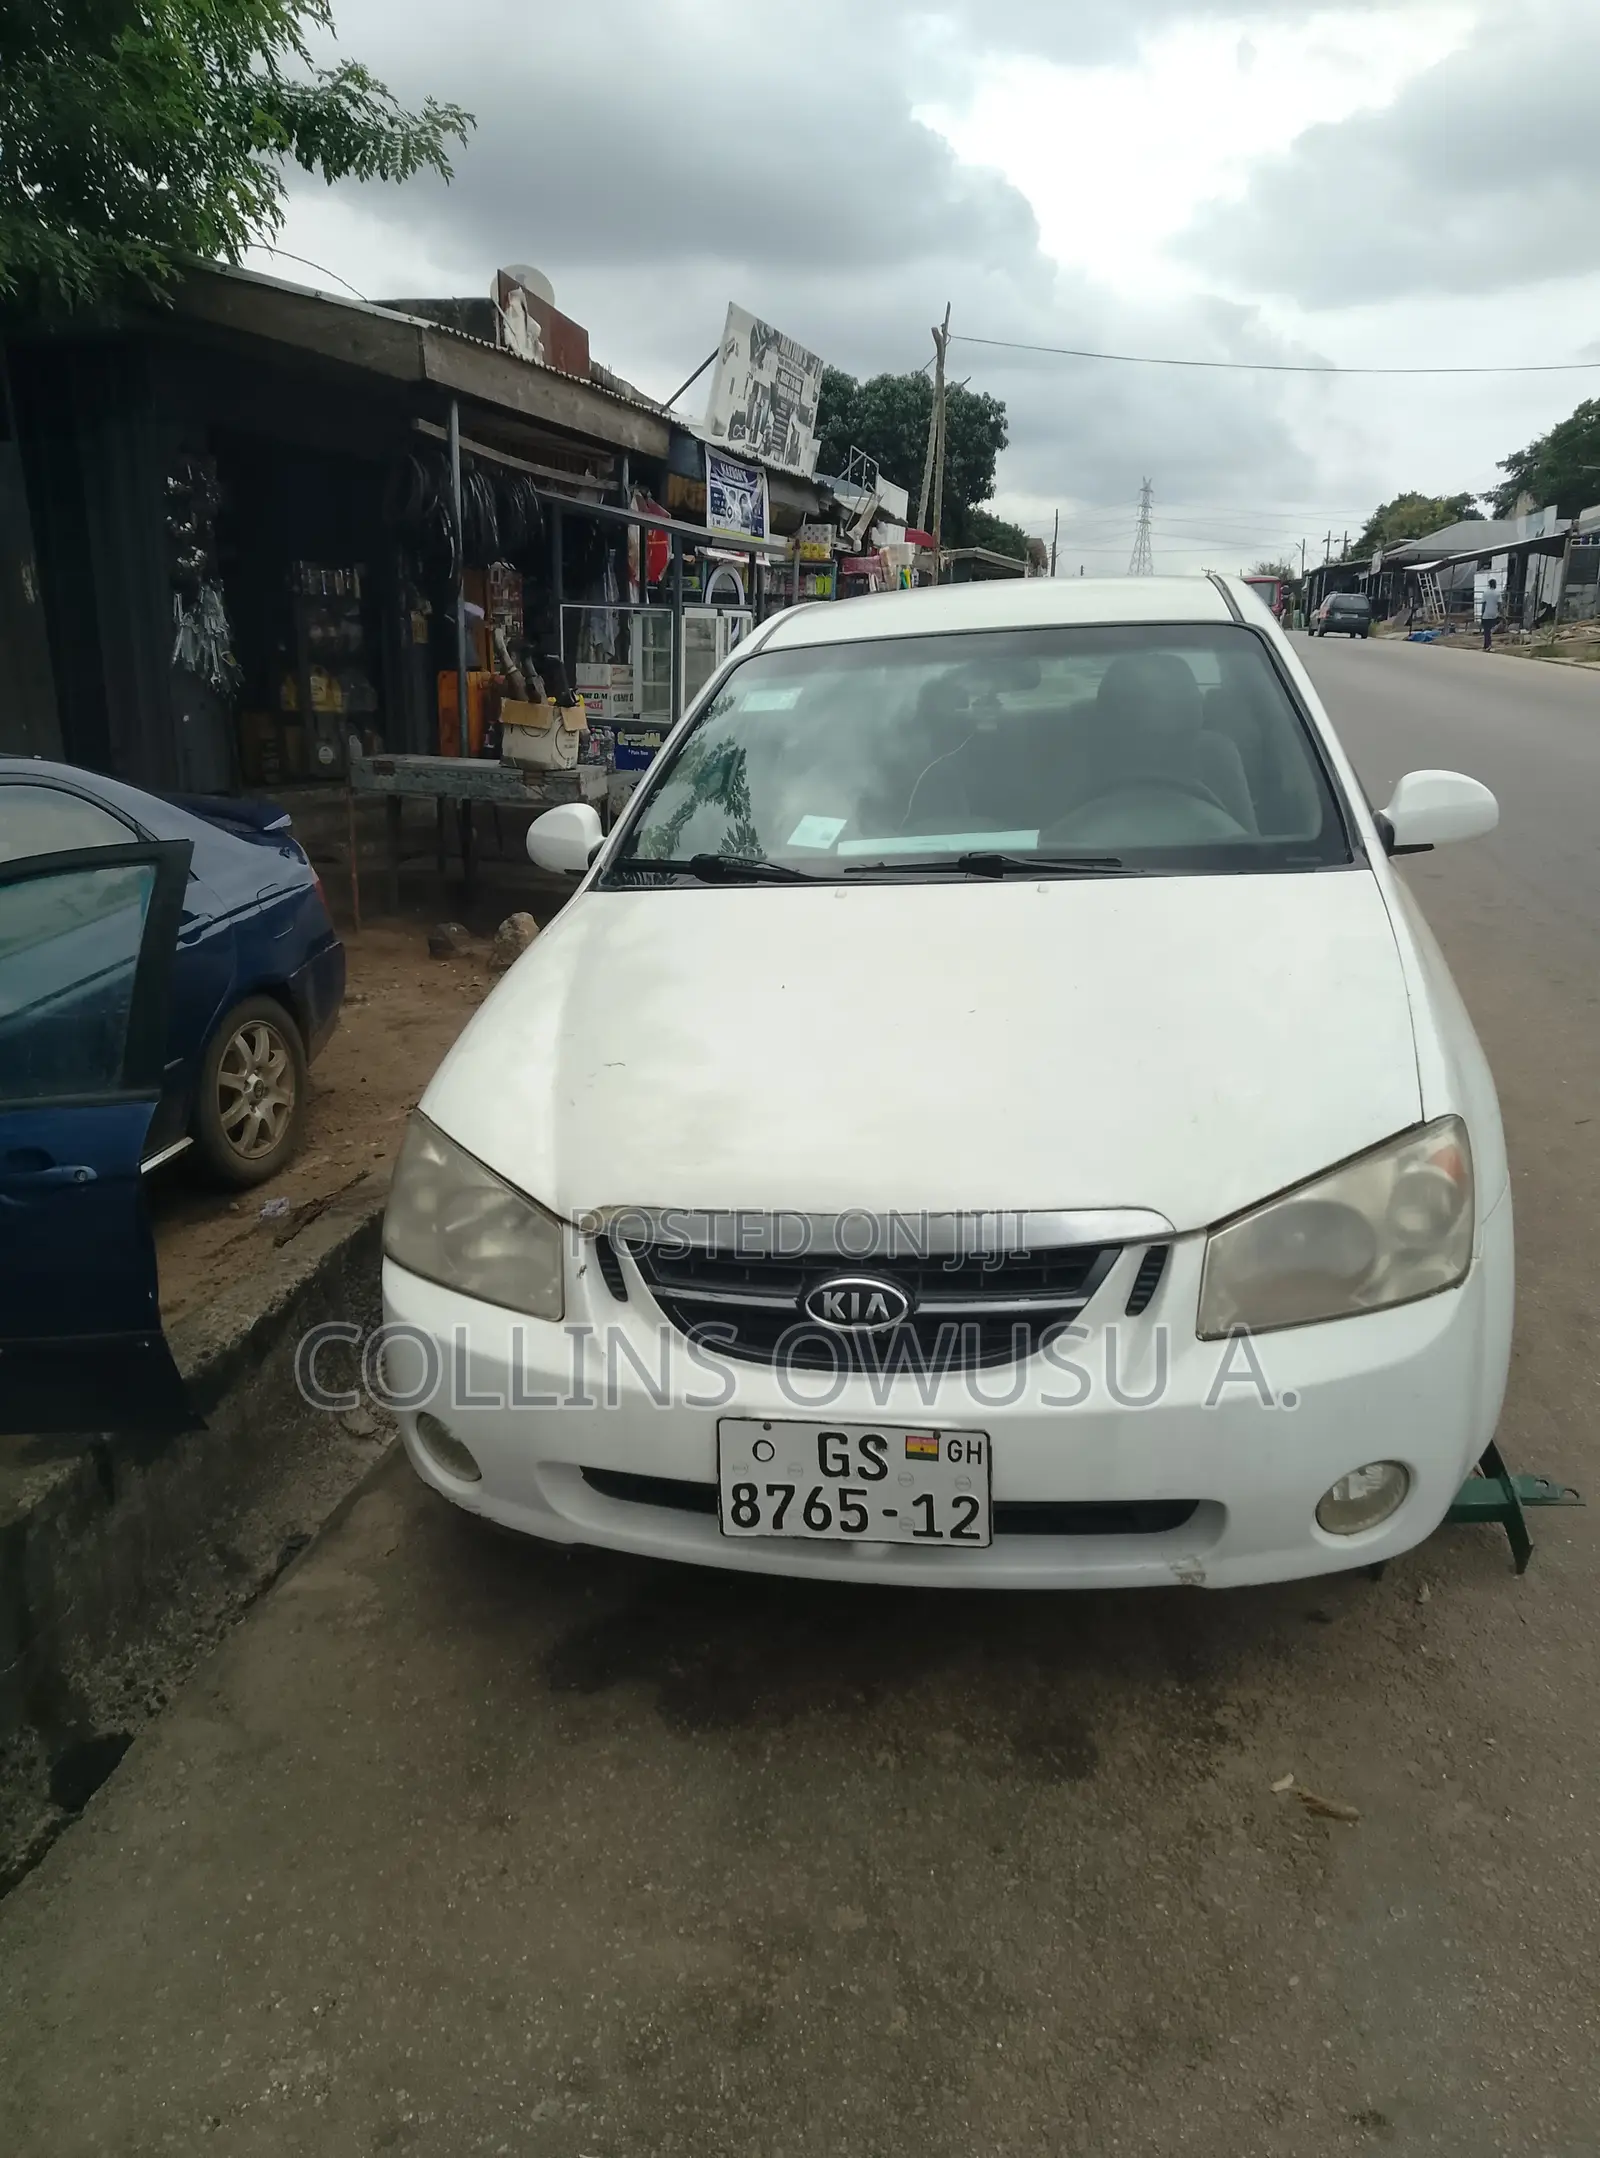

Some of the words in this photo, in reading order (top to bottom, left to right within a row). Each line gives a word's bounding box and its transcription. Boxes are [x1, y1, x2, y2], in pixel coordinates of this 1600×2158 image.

[823, 1292, 890, 1320] KIA
[817, 1431, 889, 1481] GS
[947, 1440, 982, 1464] GH
[731, 1482, 981, 1540] 8765-12
